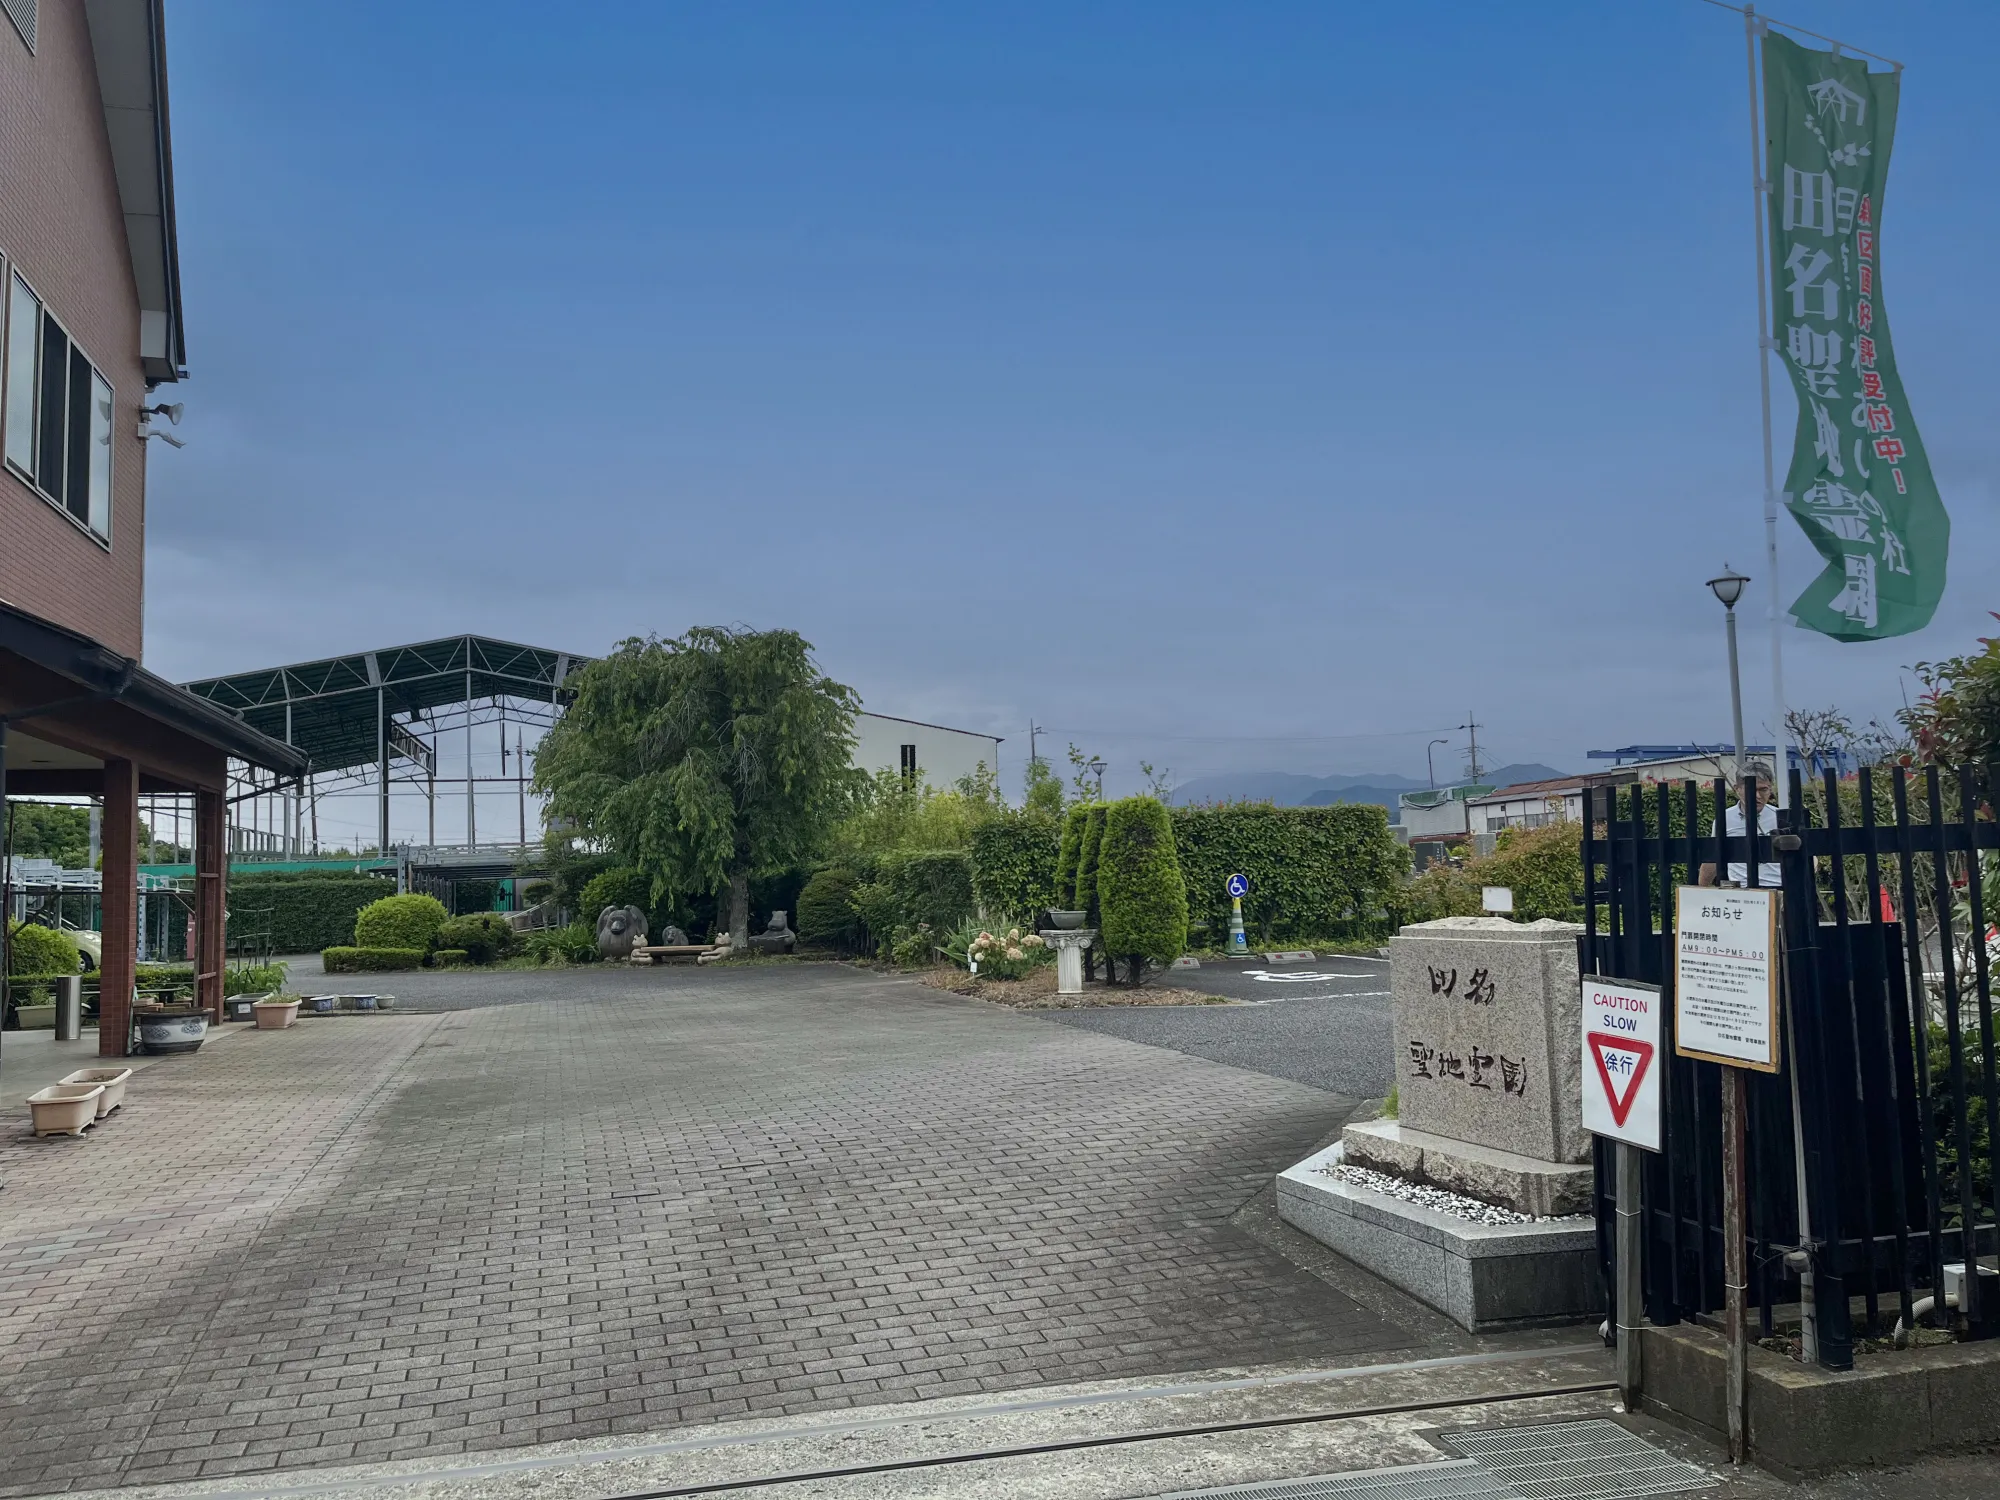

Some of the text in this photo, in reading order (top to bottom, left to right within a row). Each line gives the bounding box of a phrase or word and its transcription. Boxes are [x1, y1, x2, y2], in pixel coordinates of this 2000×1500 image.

[1701, 905, 1743, 920] お知らせ
[1593, 993, 1648, 1014] CAUTION
[1603, 1014, 1637, 1032] SLOW
[1604, 1051, 1633, 1076] 徐行
